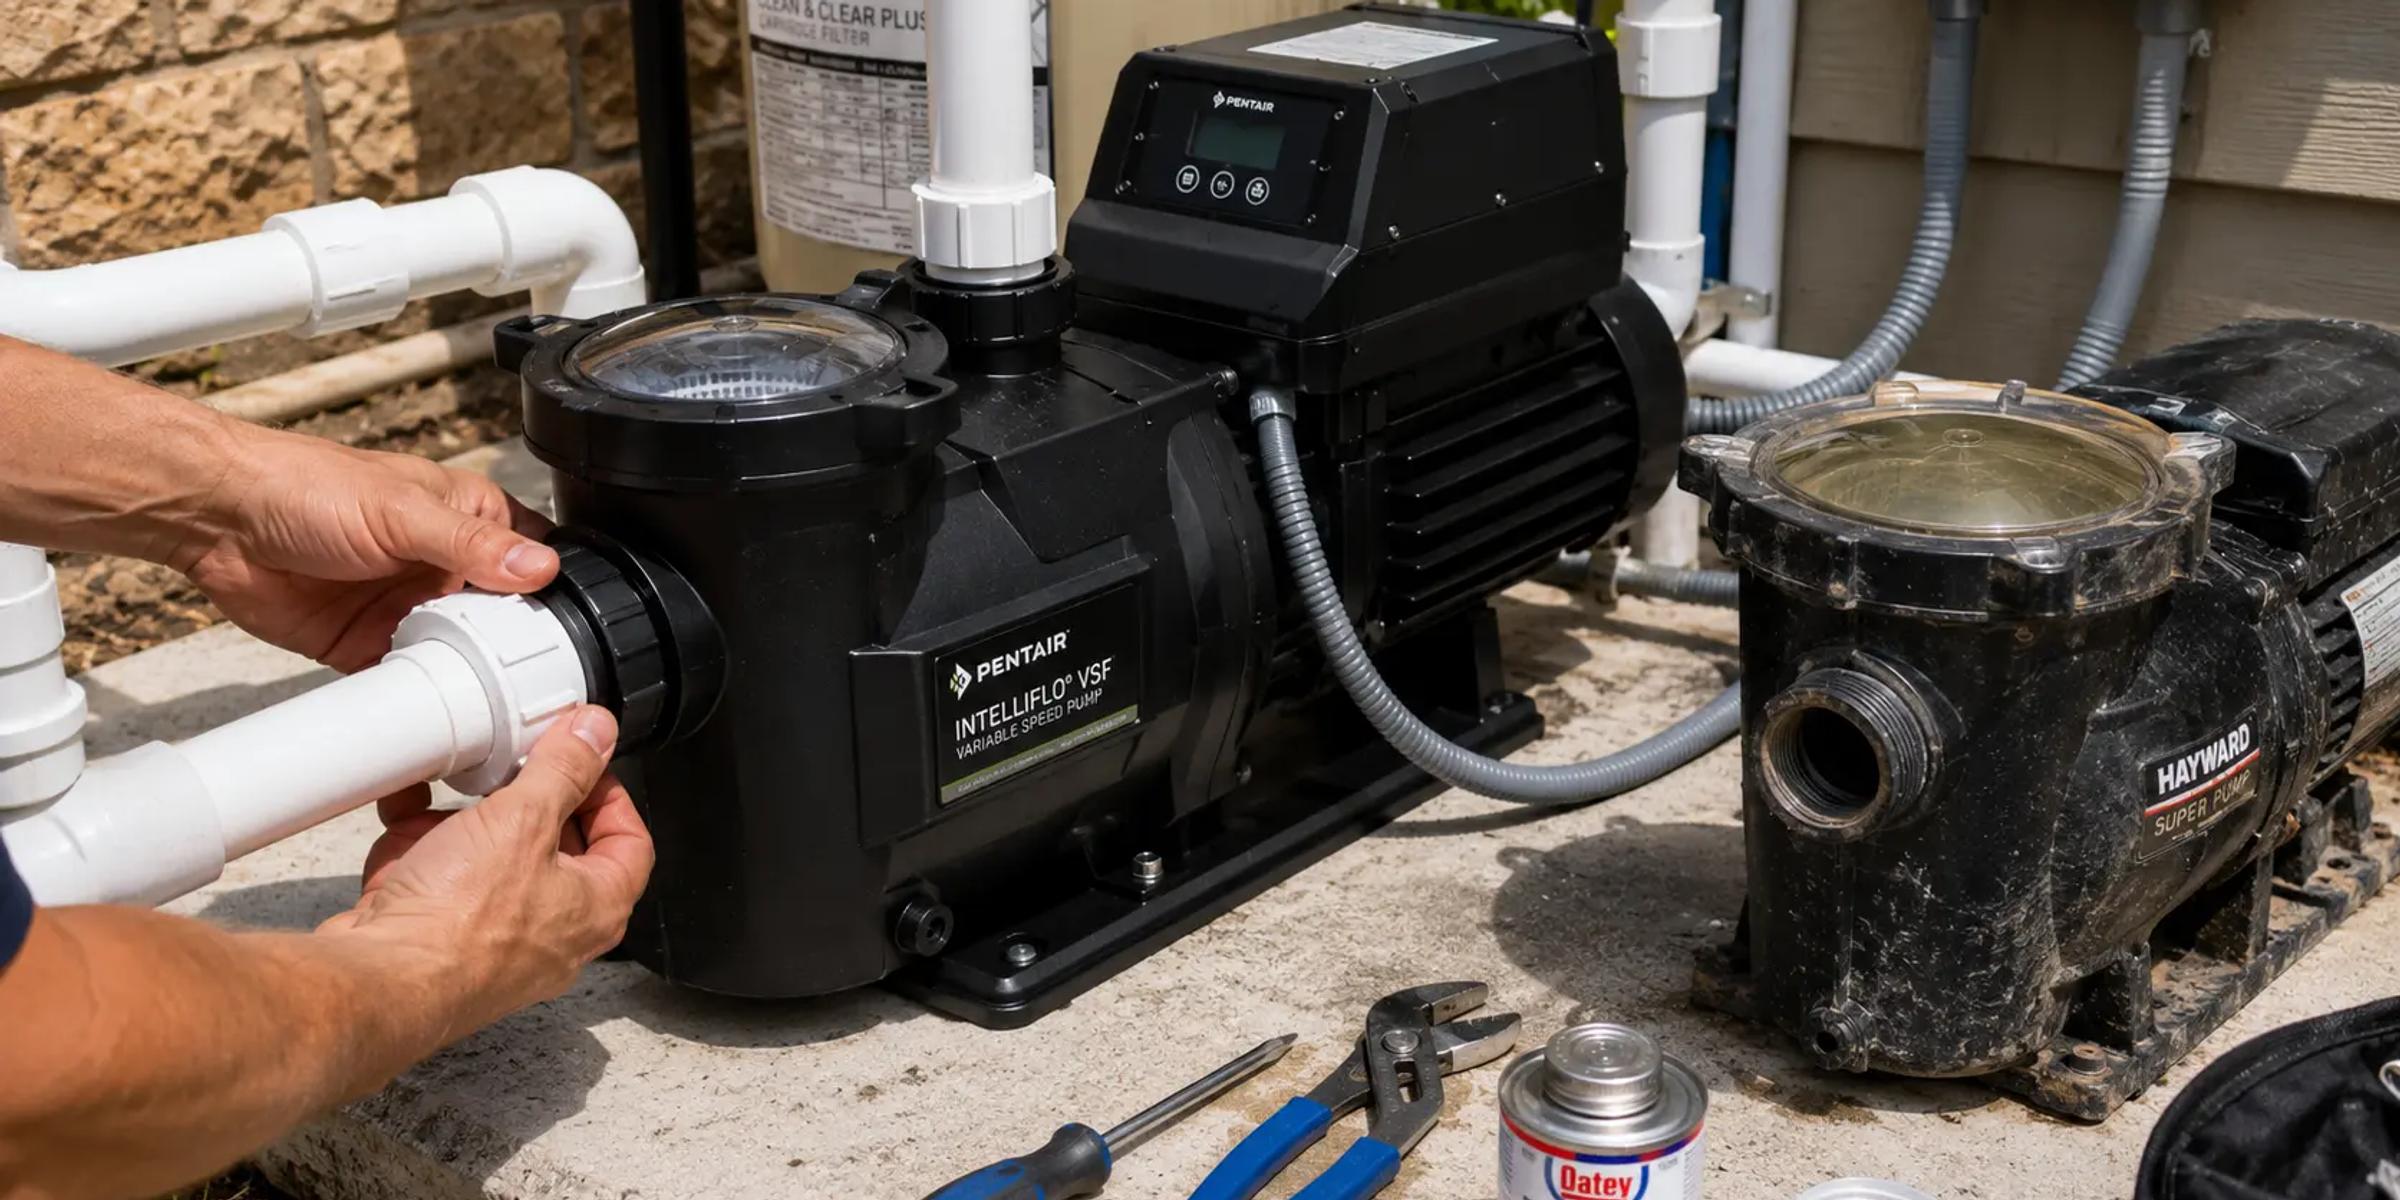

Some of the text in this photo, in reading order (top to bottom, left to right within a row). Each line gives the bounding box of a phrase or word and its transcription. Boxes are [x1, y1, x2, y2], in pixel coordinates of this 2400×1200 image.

[818, 1, 875, 27] CLEAR
[821, 25, 870, 46] FILTER
[1226, 96, 1274, 112] PENTAIR
[977, 631, 1068, 683] PENTAIR
[1077, 657, 1112, 689] VSF
[956, 723, 1018, 760] VARIABLE
[1021, 704, 1063, 733] SPEED
[2157, 723, 2250, 795] HAYWARD
[2154, 798, 2207, 837] SUPER
